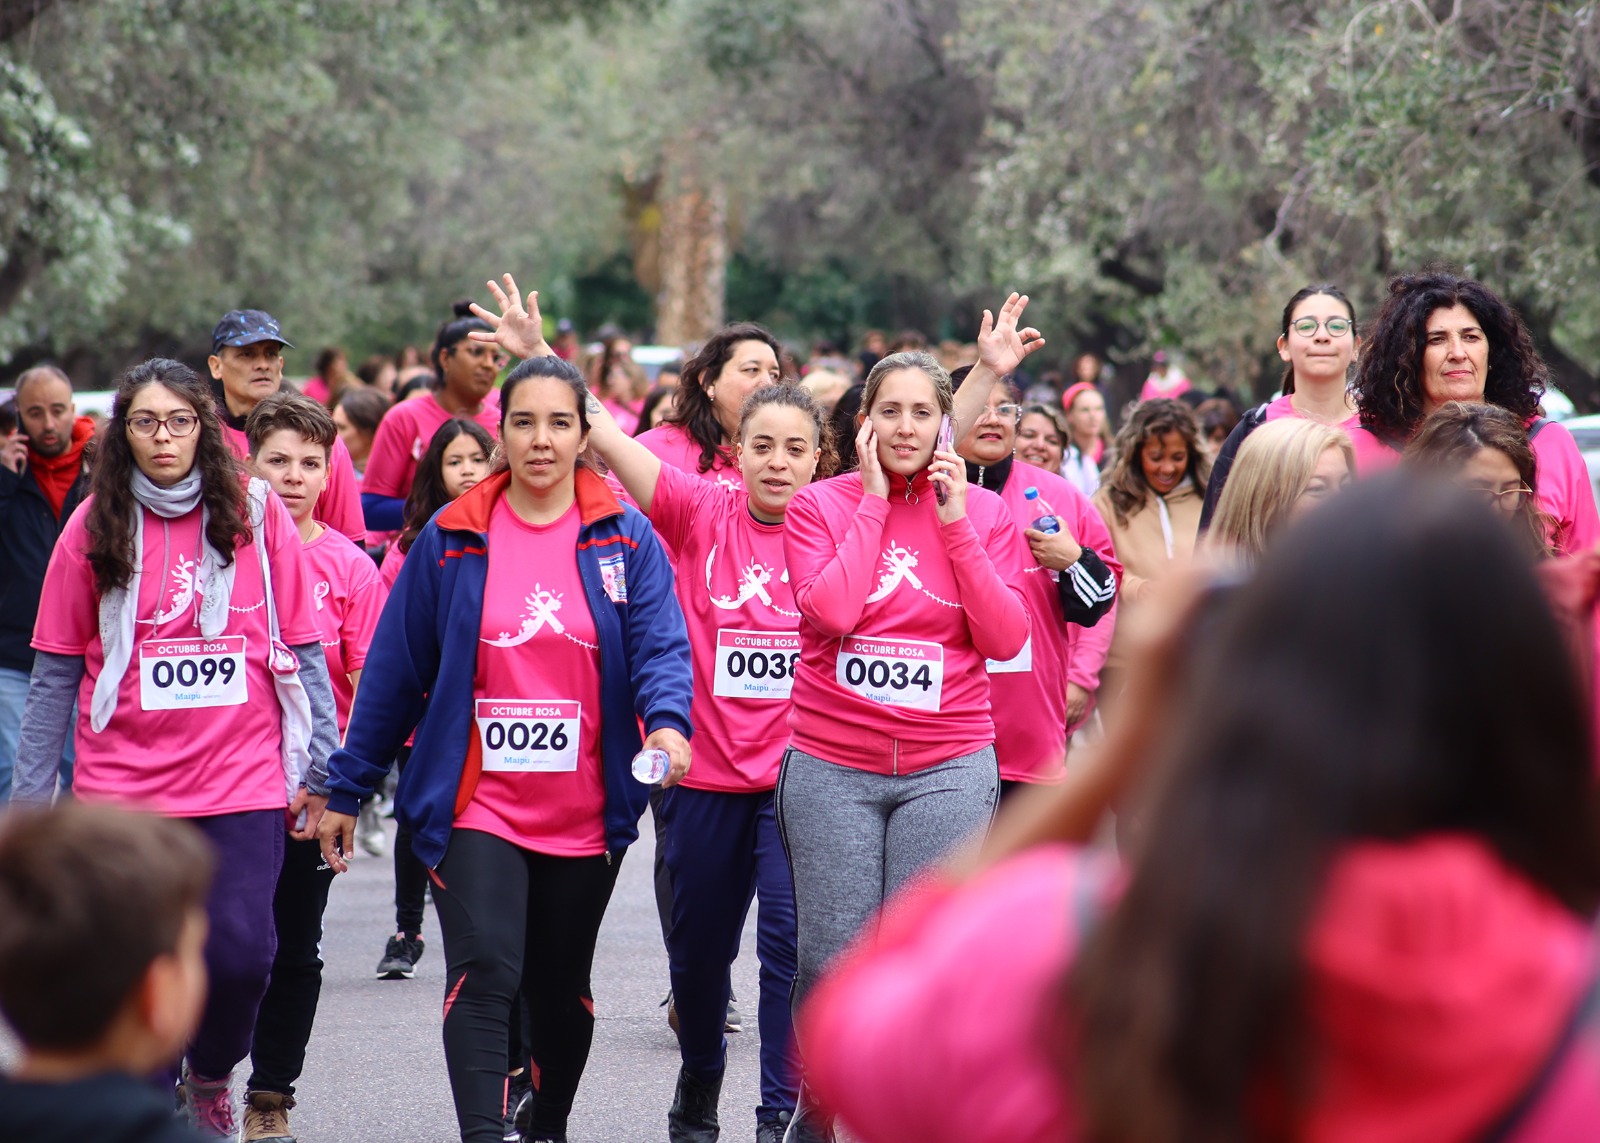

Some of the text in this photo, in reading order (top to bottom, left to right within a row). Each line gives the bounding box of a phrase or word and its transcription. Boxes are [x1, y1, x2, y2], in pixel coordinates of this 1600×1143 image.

[157, 643, 228, 654] OCTUBRE ROSA
[734, 637, 799, 647] OCTUBRE ROSA
[854, 643, 925, 658] OCTUBRE ROSA
[152, 657, 236, 688] 0099
[845, 657, 933, 692] 0034
[491, 707, 562, 716] OCTUBRE ROSA
[486, 721, 568, 751] 0026
